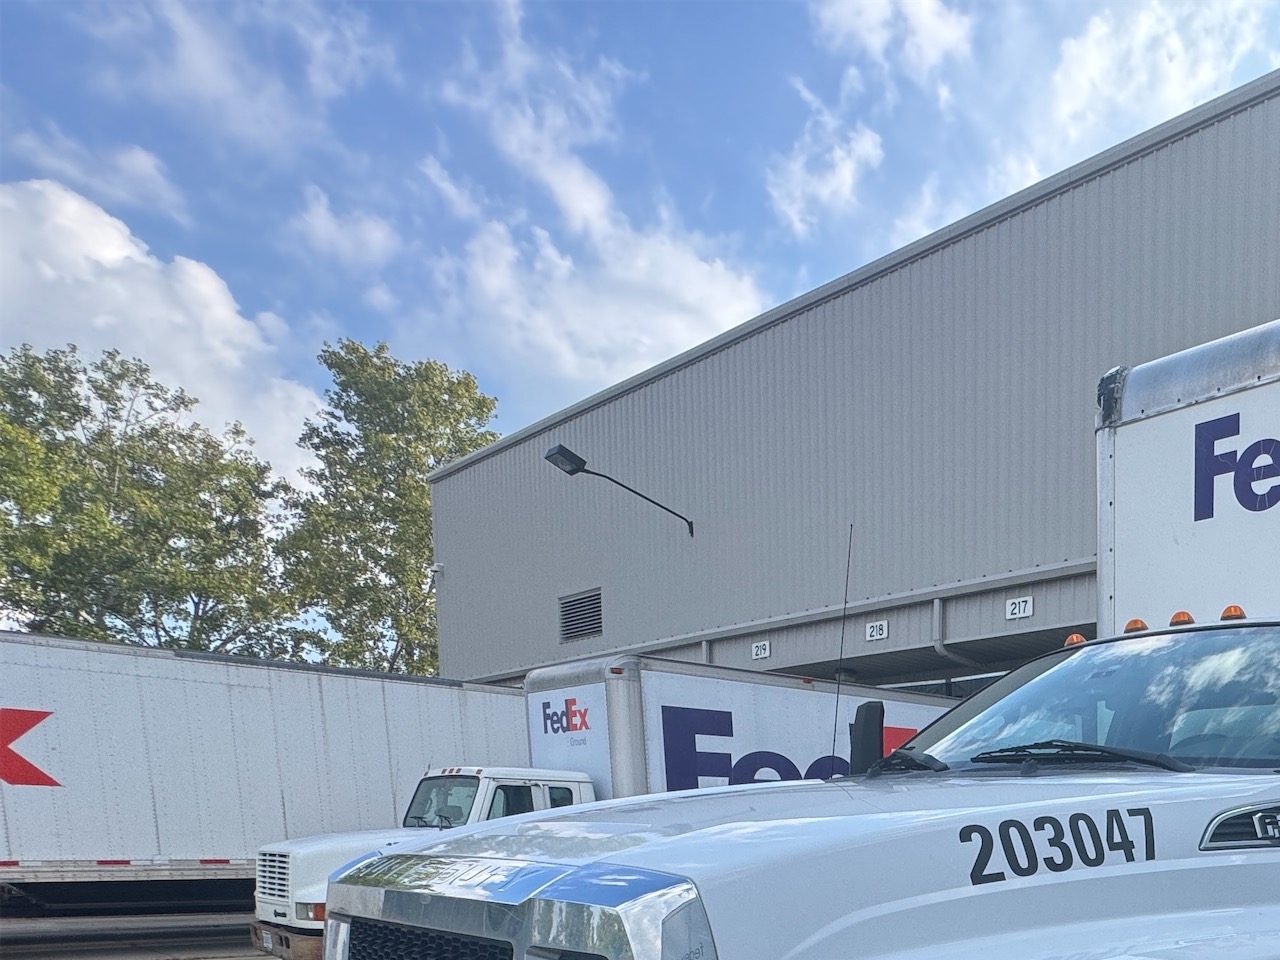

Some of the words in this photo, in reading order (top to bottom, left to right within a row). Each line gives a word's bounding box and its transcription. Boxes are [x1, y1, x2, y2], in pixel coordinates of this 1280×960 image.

[1010, 600, 1028, 615] 217
[869, 624, 884, 638] 218
[754, 643, 767, 657] 219
[542, 698, 589, 734] FedEx
[959, 807, 1157, 886] 203047
